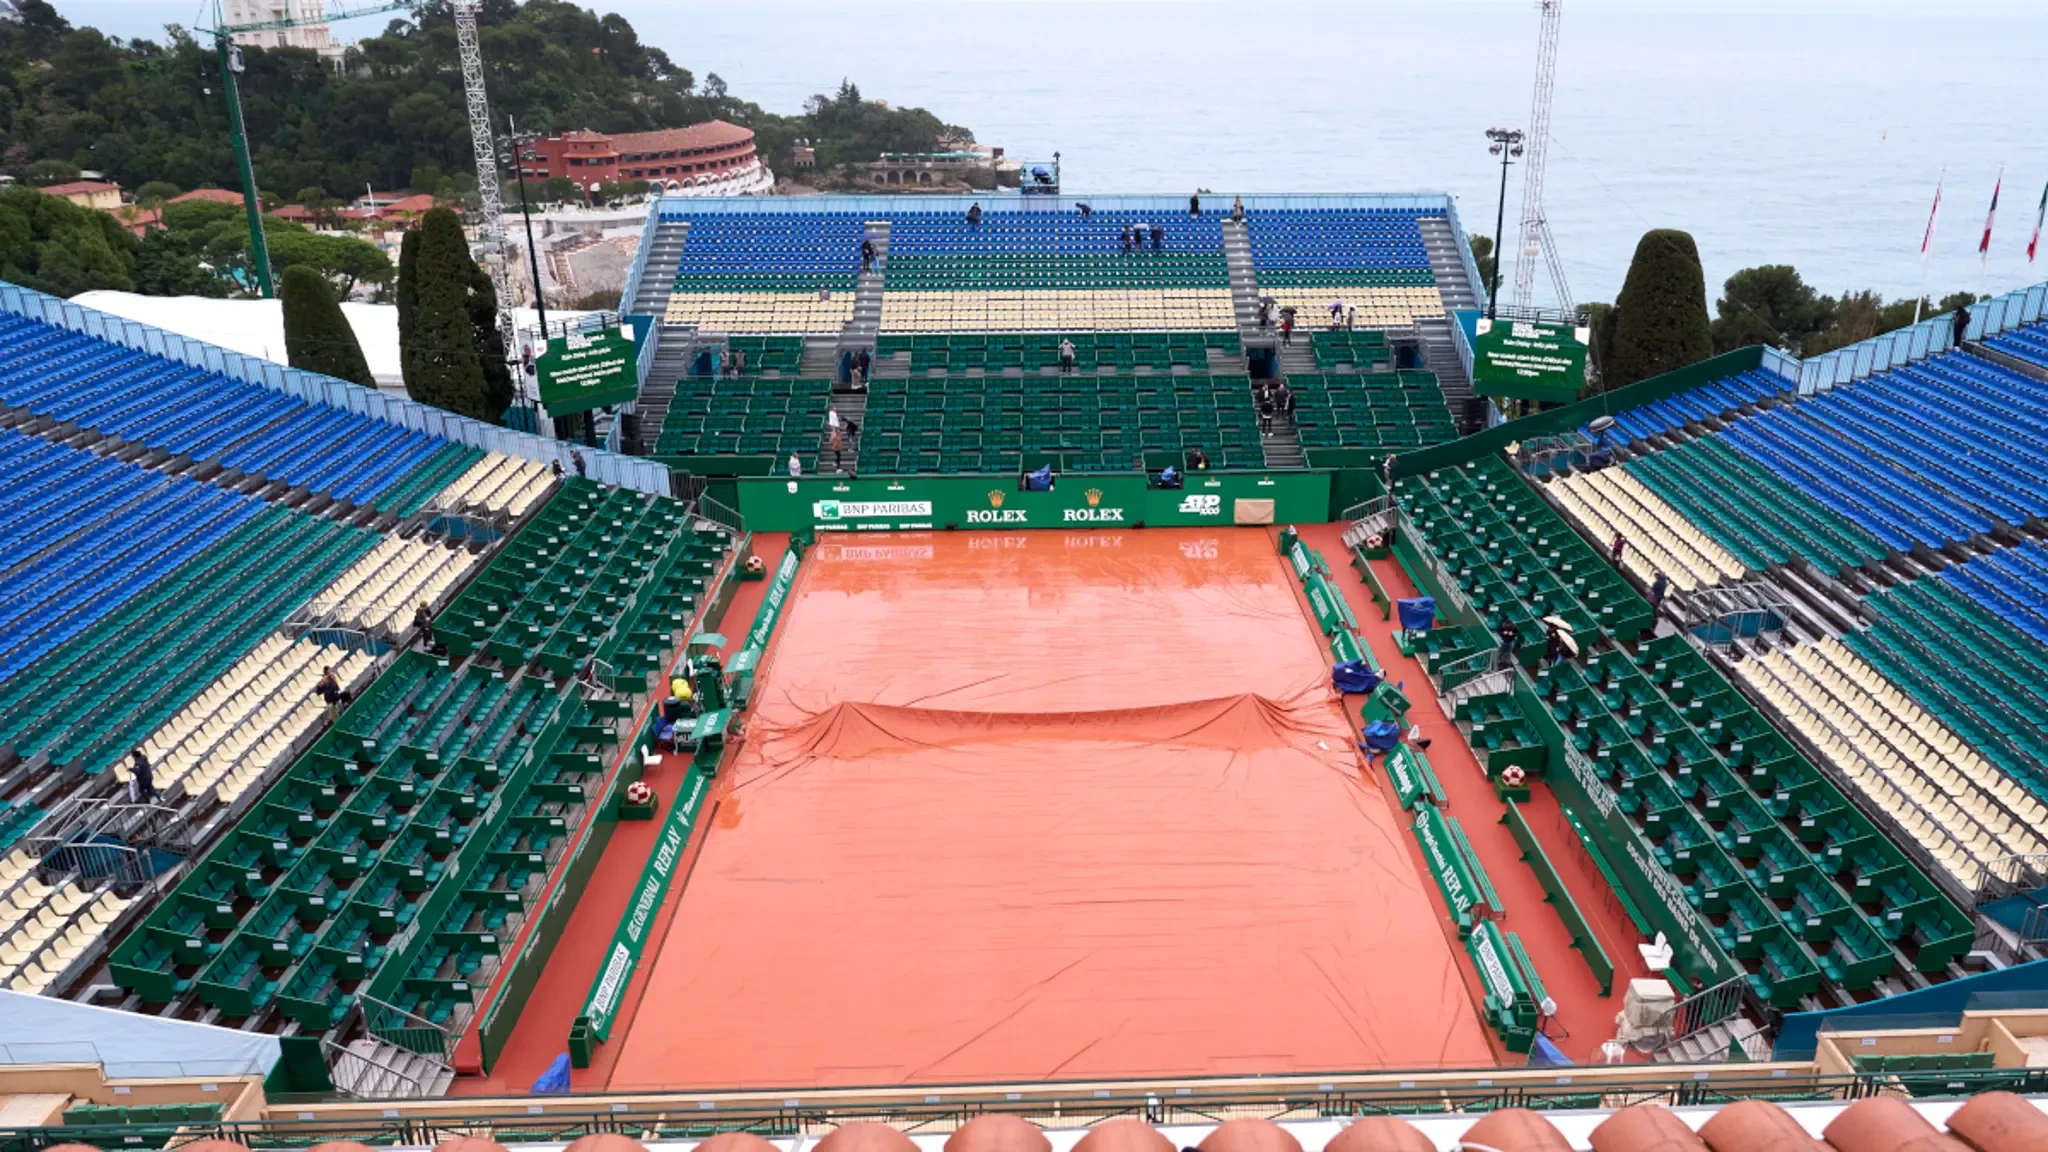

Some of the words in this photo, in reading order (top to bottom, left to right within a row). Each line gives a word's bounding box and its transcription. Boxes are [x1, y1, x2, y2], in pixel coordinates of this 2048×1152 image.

[842, 503, 869, 515] BNP
[872, 503, 926, 514] PARIBAS
[966, 509, 1028, 523] ROLEX
[1063, 508, 1124, 521] ROLEX
[1199, 507, 1221, 516] 1000
[1441, 864, 1471, 913] REPLAY
[595, 985, 610, 1010] BNP
[604, 947, 626, 989] PARIBAS
[633, 874, 661, 927] GENERALI
[653, 824, 682, 878] REPLAY
[1688, 928, 1701, 949] DE
[1699, 943, 1718, 975] MER
